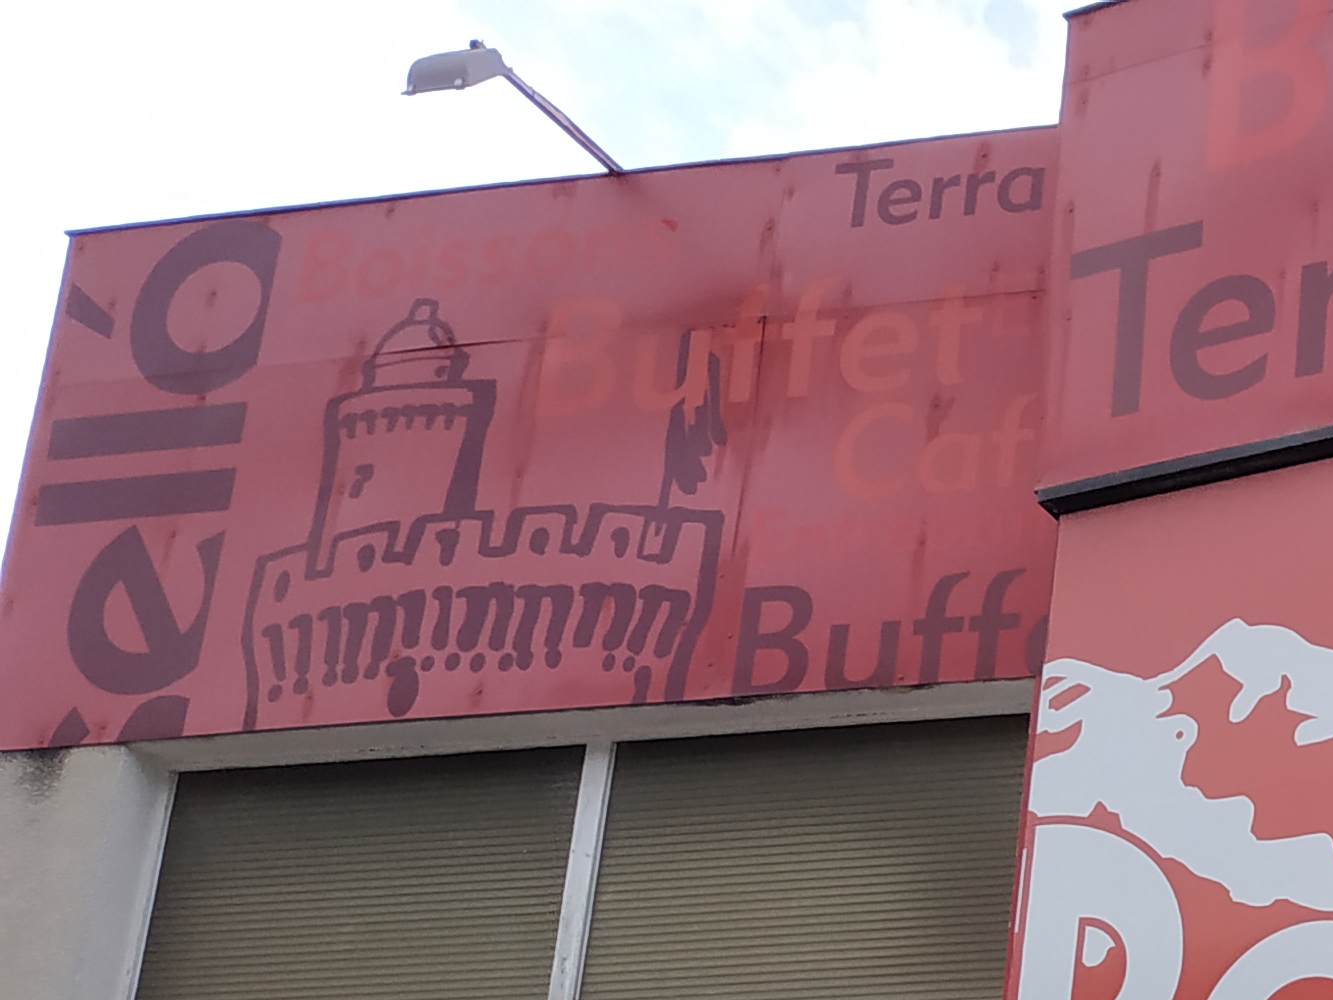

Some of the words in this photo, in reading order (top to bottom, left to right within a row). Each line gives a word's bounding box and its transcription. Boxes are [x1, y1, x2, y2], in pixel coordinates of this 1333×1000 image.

[834, 157, 1046, 228] Terra
[297, 212, 682, 304] Boissons
[534, 270, 988, 420] Buffet
